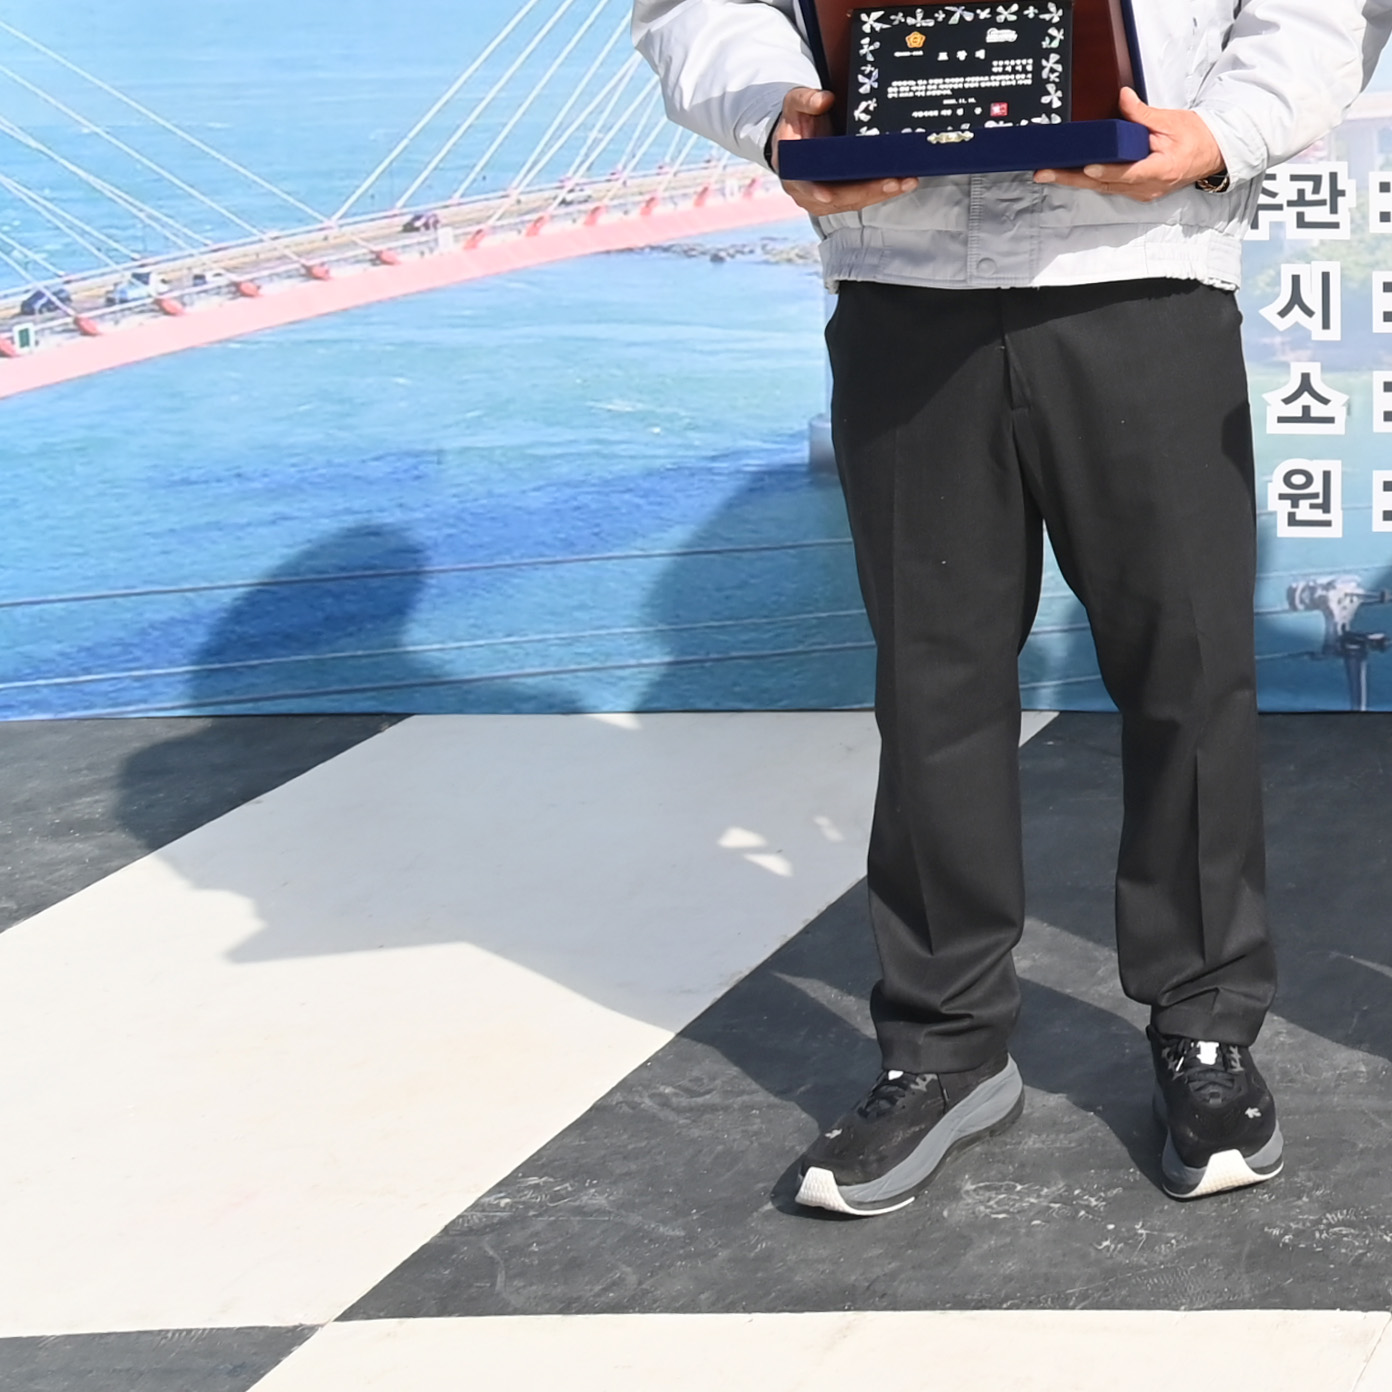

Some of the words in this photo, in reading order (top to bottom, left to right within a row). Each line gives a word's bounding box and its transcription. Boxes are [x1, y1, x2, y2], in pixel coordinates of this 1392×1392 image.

[1275, 270, 1331, 331] 시
[1276, 371, 1336, 424] 소
[1277, 468, 1333, 528] 원
